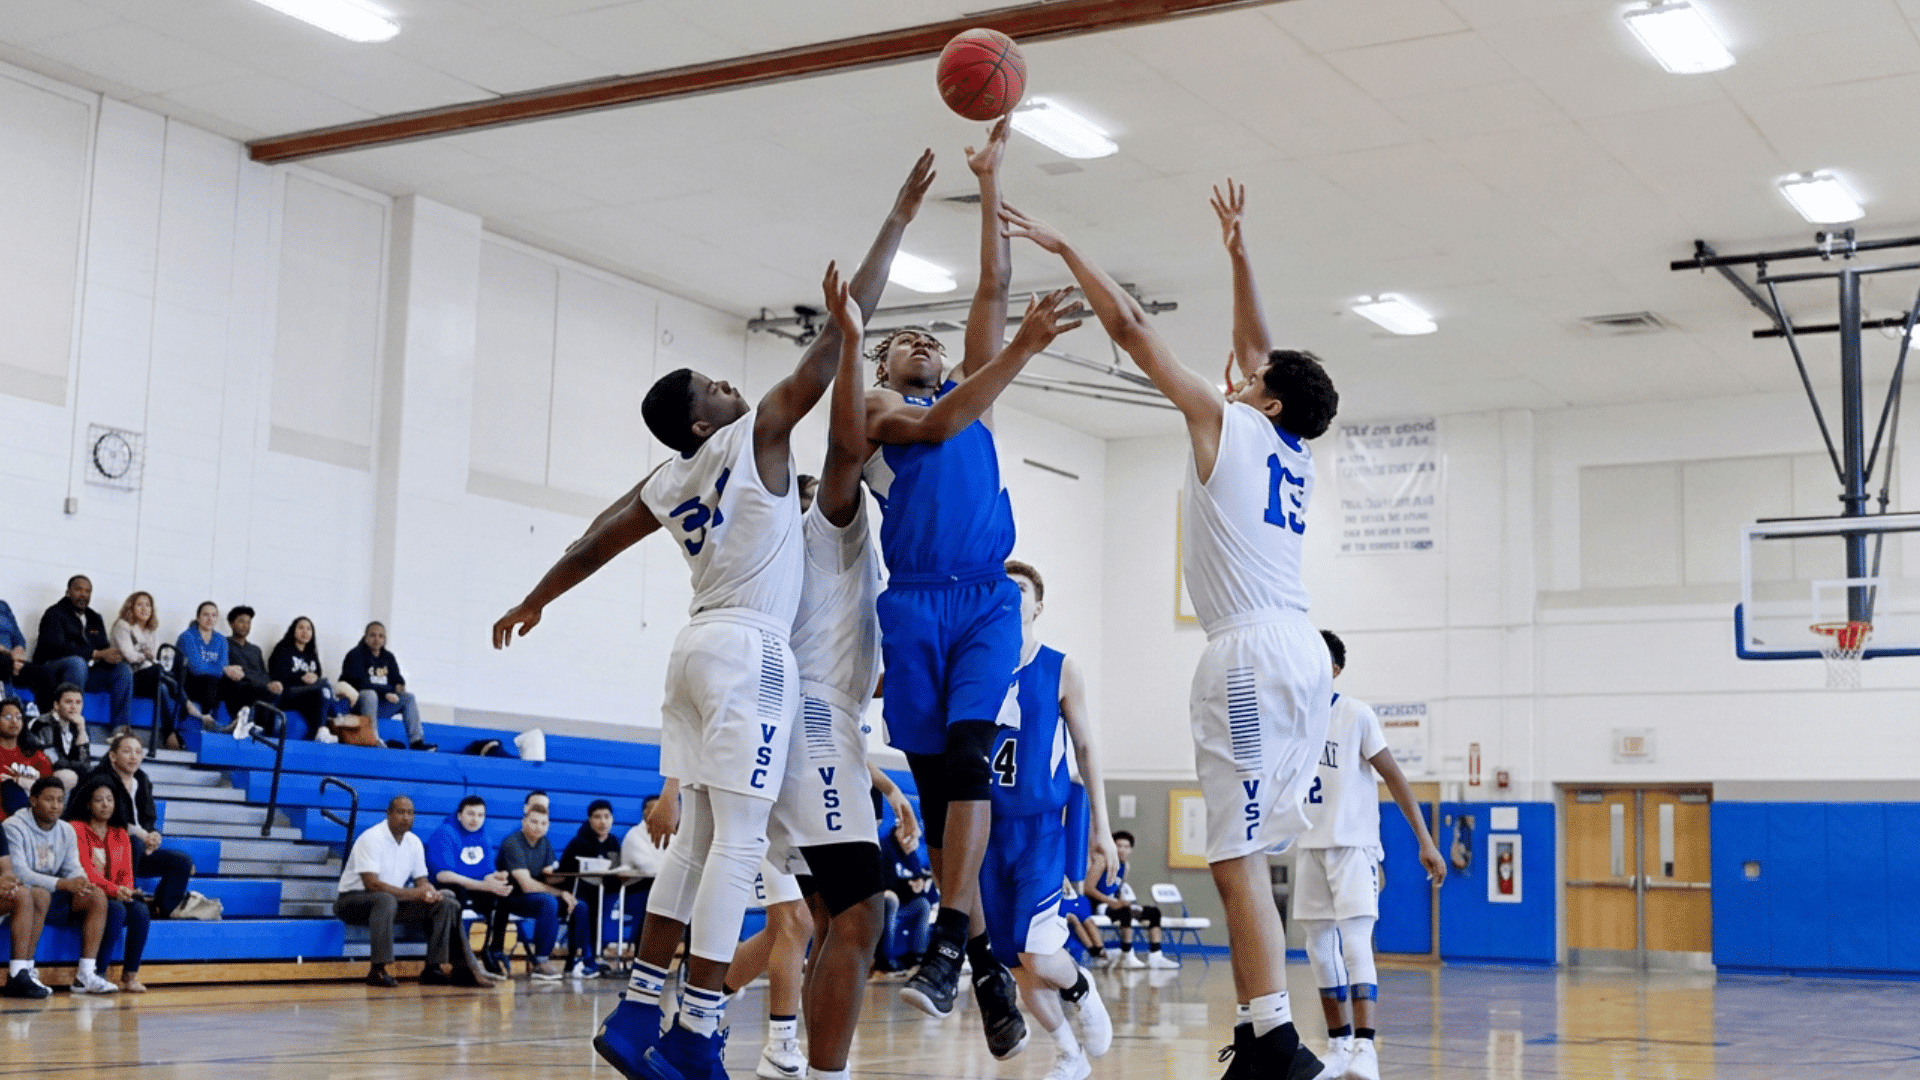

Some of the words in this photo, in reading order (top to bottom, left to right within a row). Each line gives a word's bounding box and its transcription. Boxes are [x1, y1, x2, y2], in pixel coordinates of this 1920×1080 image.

[669, 467, 730, 556] 31
[750, 723, 777, 789] VSC
[818, 767, 843, 831] VSC
